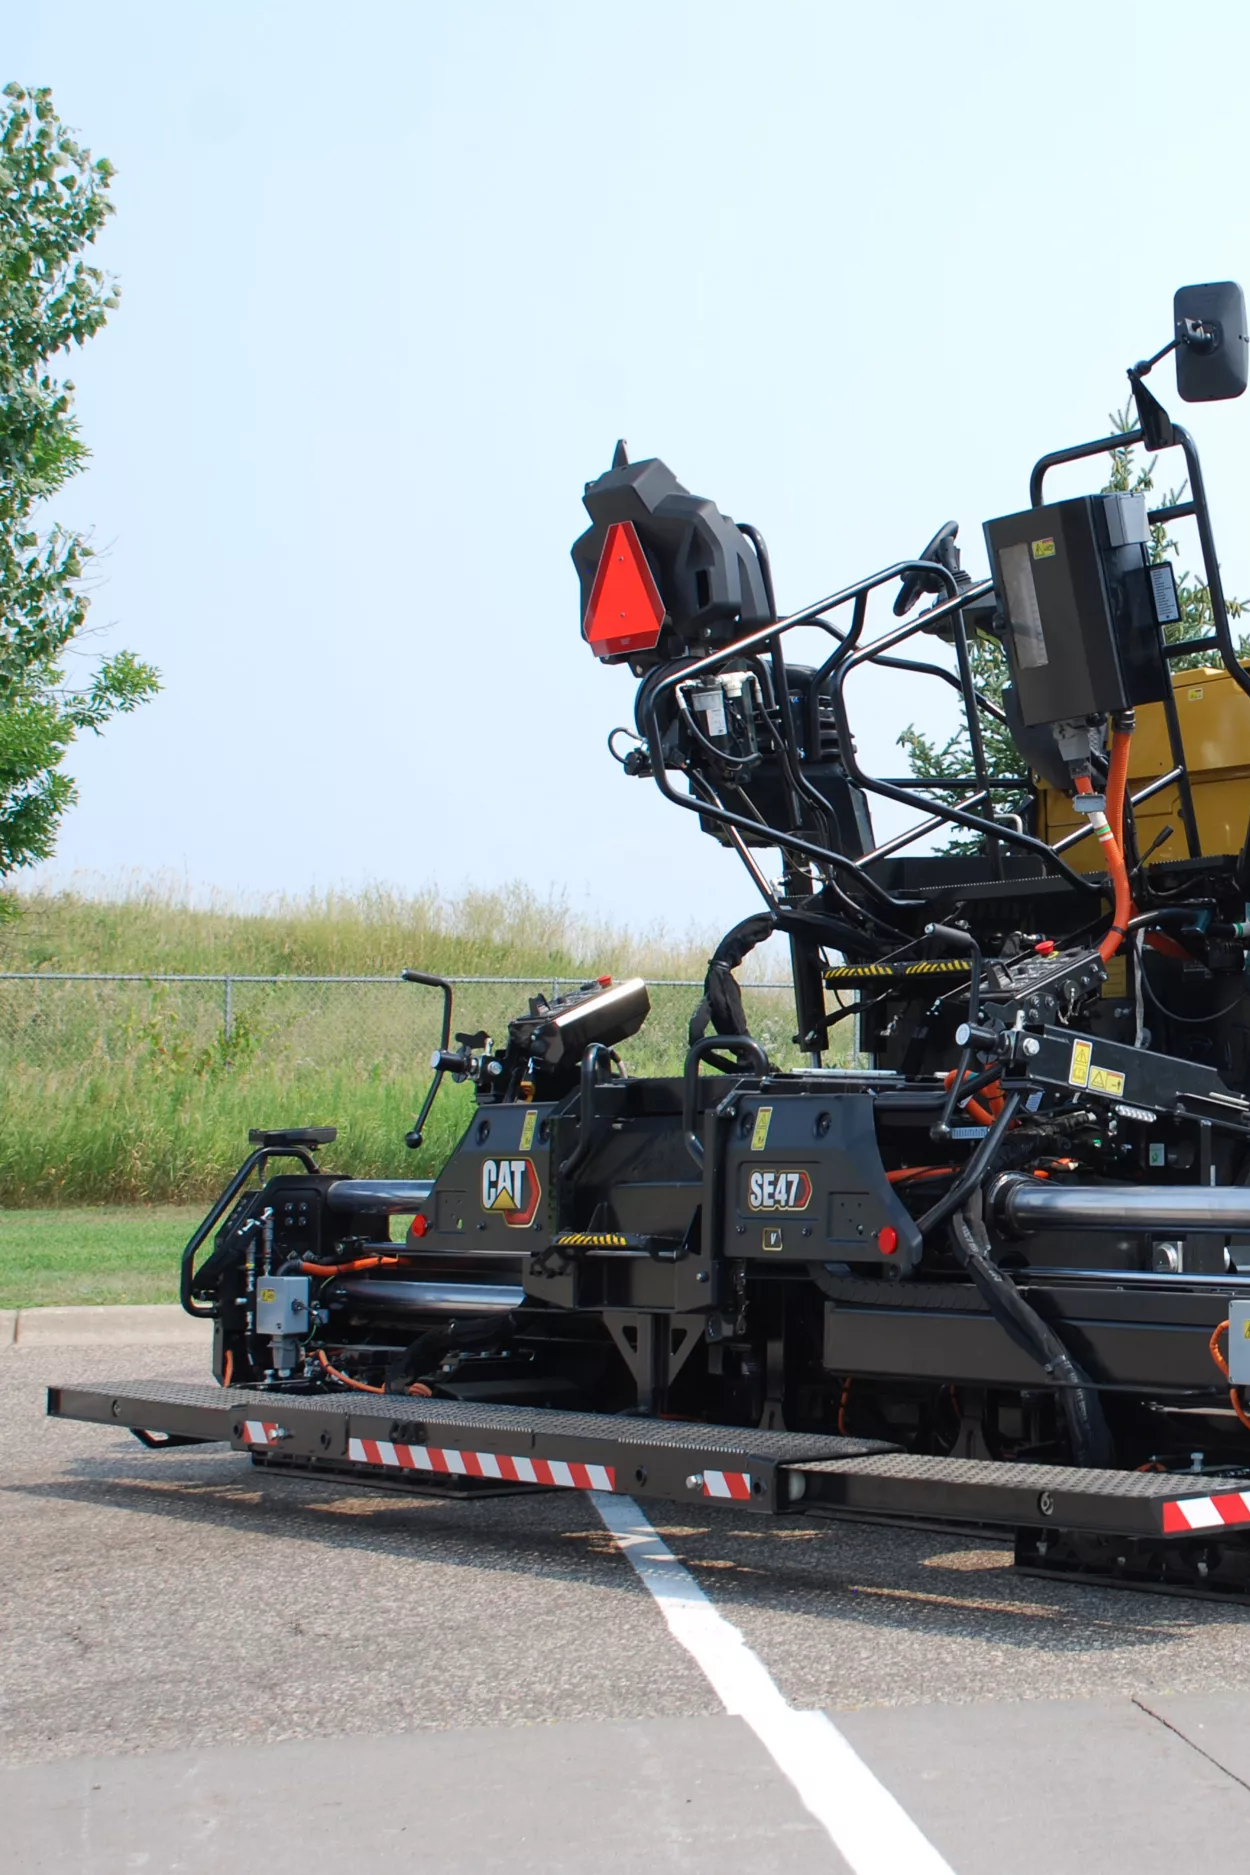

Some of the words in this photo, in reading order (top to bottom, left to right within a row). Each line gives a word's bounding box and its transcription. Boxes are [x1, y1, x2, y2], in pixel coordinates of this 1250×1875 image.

[482, 1160, 526, 1209] CAT
[750, 1172, 800, 1207] SE47
[770, 1232, 777, 1245] V
